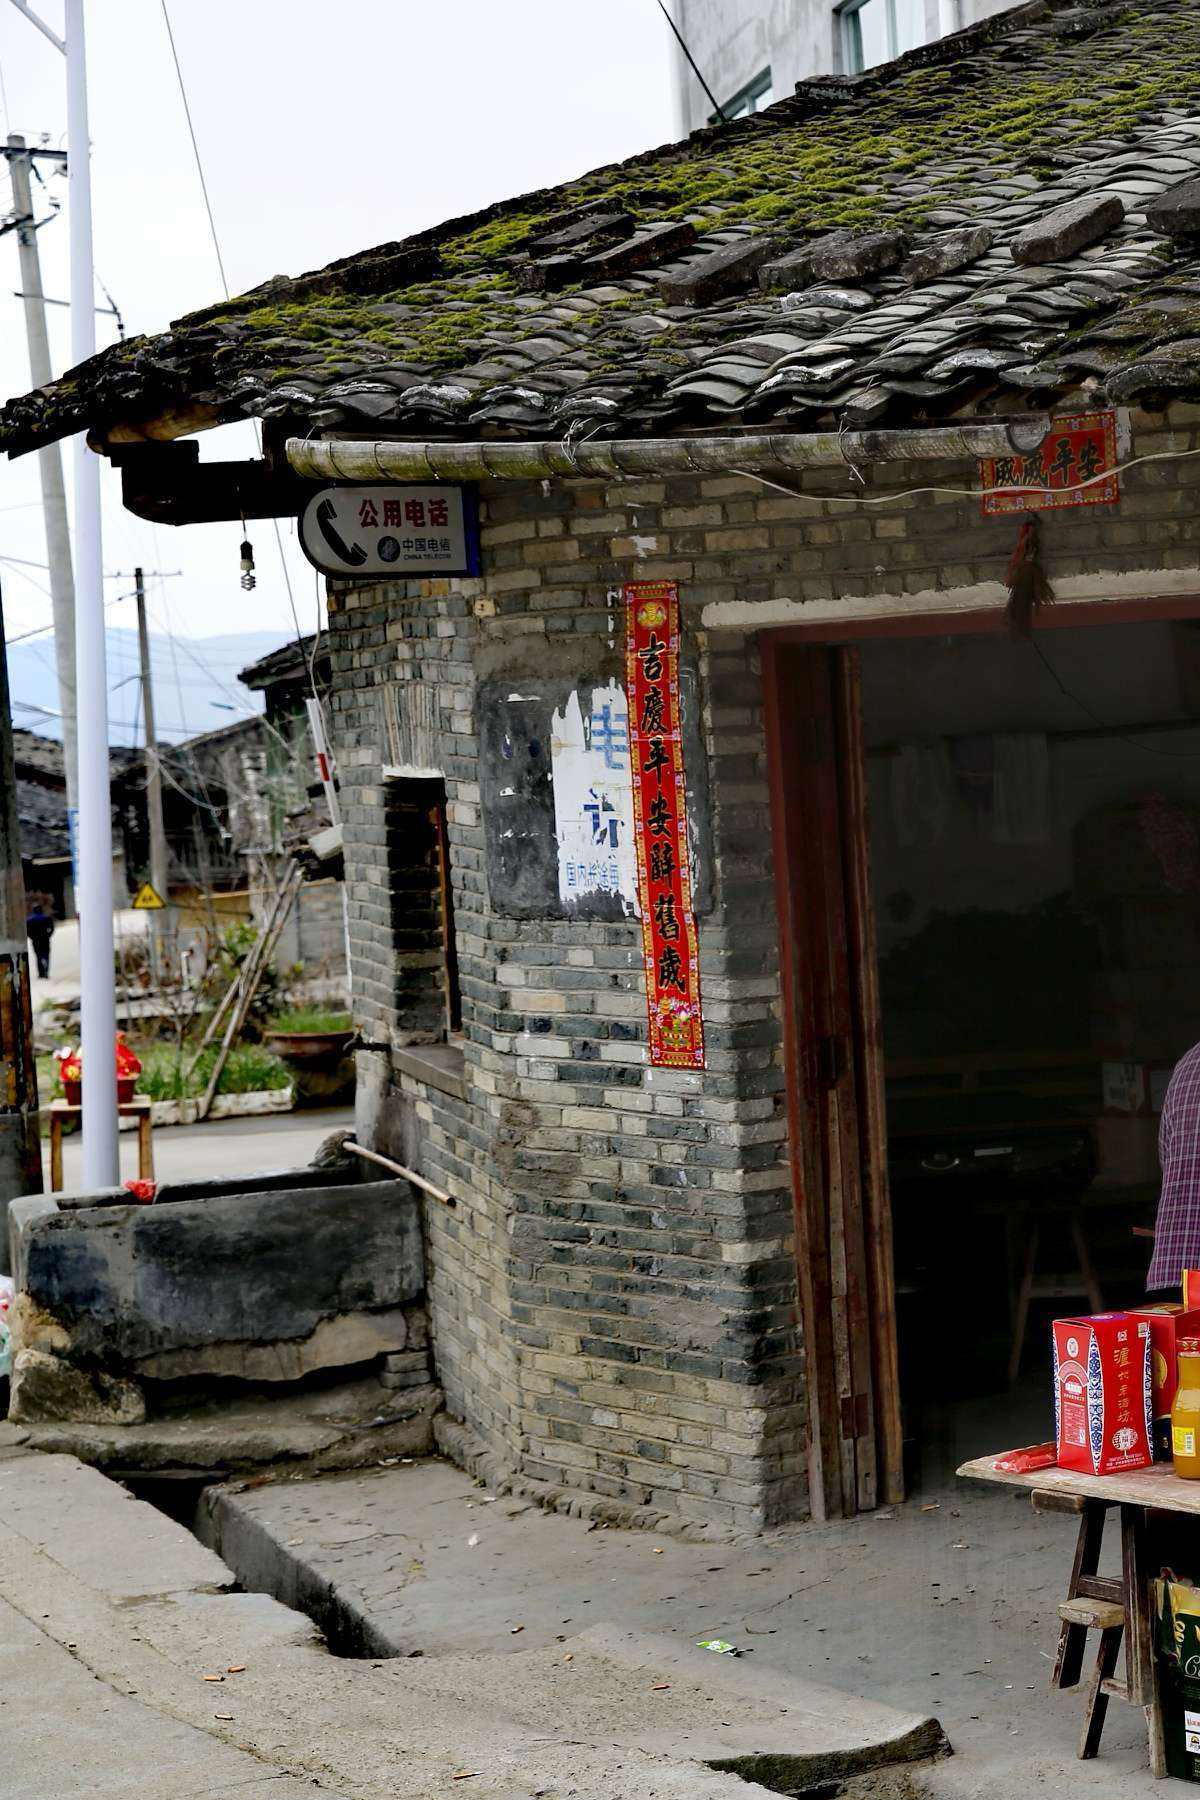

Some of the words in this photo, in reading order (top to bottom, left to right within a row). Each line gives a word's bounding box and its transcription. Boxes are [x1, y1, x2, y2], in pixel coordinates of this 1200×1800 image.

[358, 499, 449, 528] 公用电话
[402, 537, 451, 552] 中国电信
